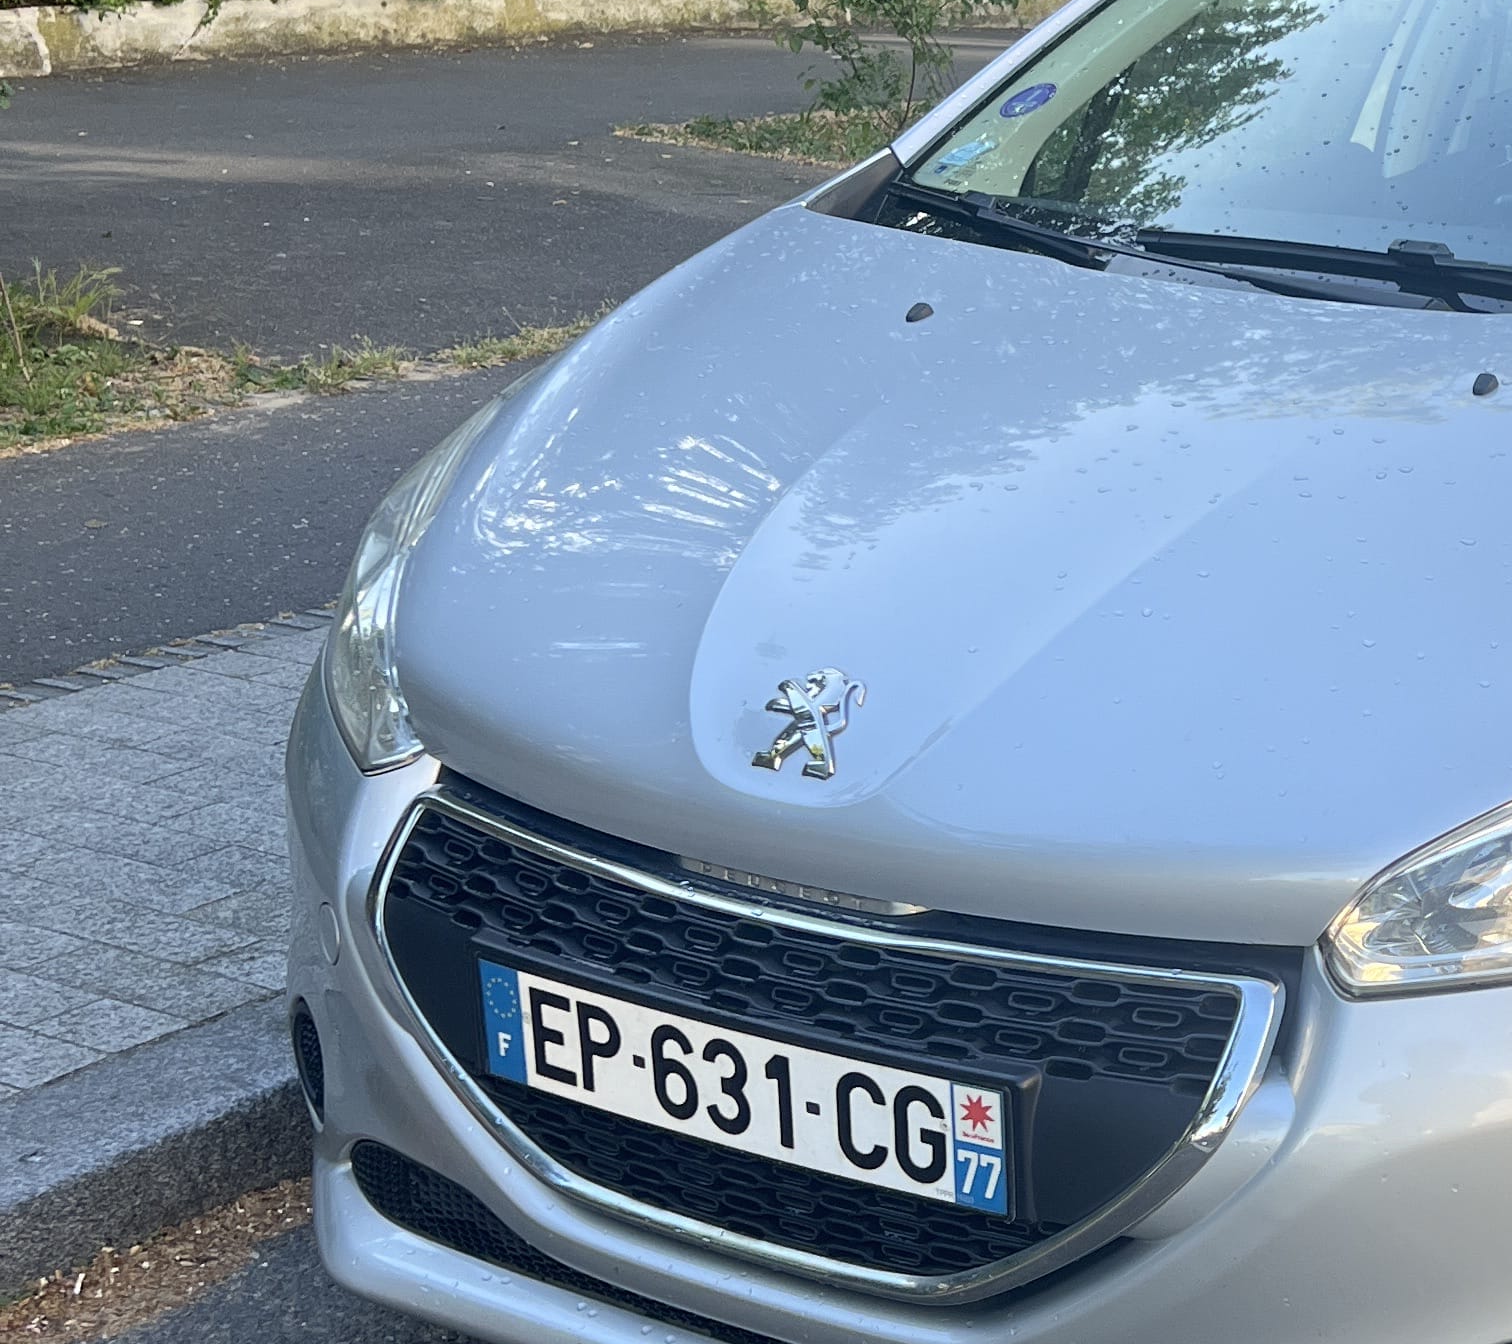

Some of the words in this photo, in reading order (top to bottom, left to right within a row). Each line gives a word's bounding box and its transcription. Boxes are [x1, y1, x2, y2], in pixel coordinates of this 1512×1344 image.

[498, 1031, 512, 1057] F
[529, 987, 947, 1184] EP-631-CG
[957, 1149, 1002, 1200] 77
